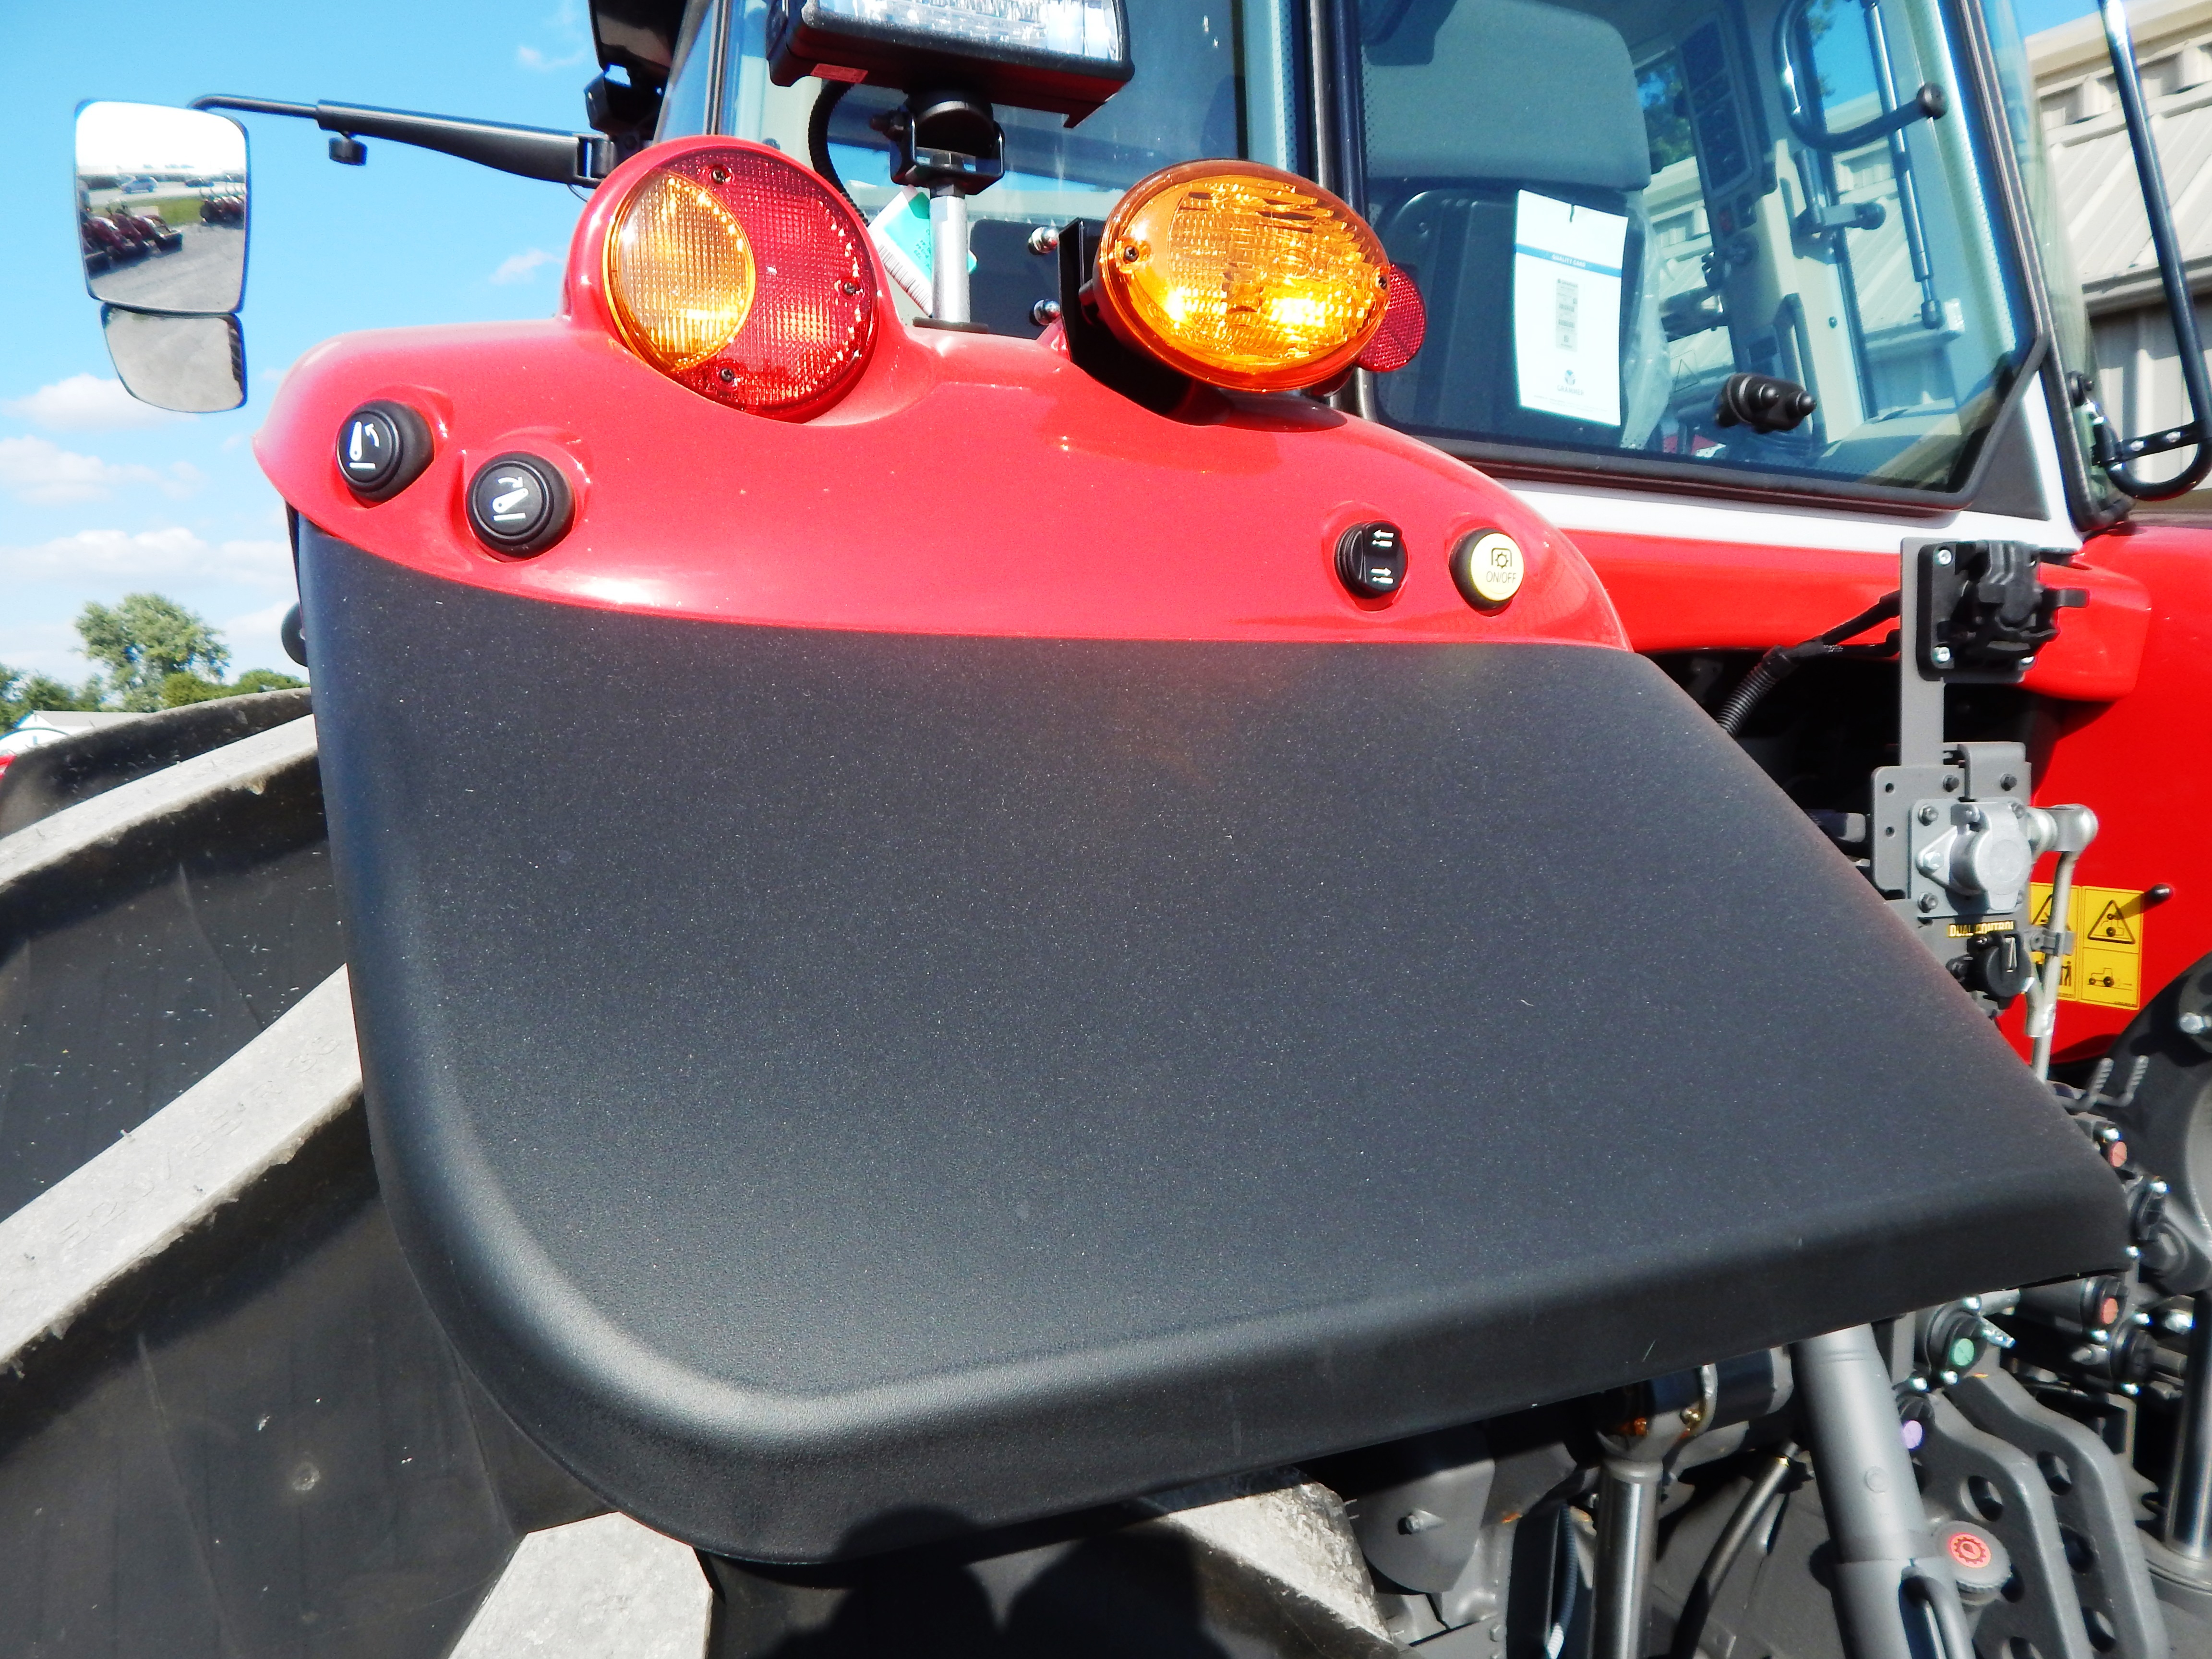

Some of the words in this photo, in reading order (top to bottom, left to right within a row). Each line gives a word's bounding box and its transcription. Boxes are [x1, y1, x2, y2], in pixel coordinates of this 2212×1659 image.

[1552, 253, 1573, 264] QUALITY
[1557, 385, 1584, 396] GRAMMER
[1486, 571, 1517, 584] ON/OFF
[1949, 924, 1973, 937] DUAL
